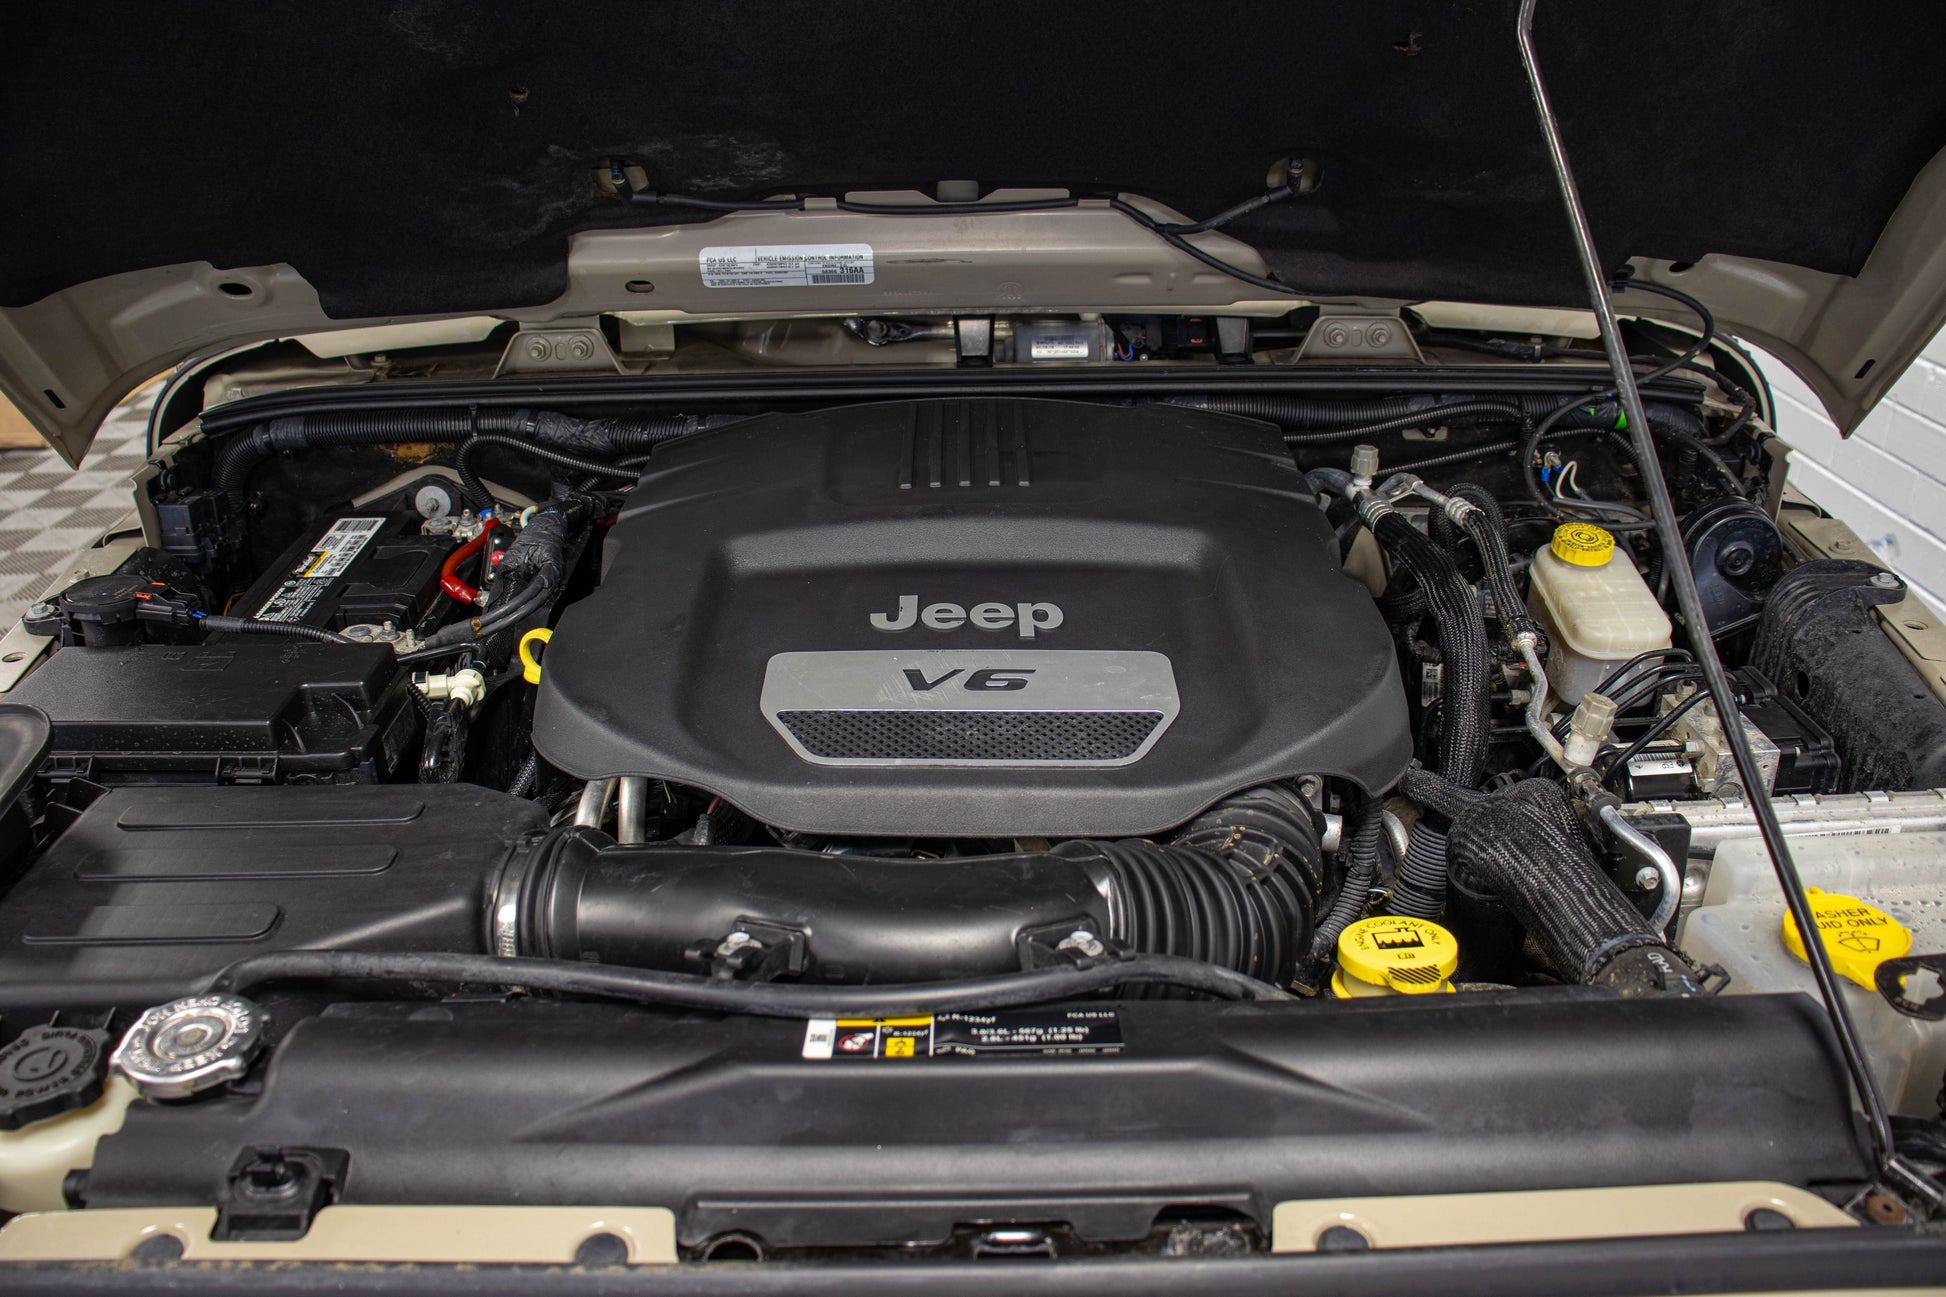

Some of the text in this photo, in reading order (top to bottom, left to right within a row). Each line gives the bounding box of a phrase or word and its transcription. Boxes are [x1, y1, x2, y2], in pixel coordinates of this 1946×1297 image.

[870, 595, 1064, 638] Jeep
[902, 668, 1036, 692] V6
[1815, 907, 1869, 918] ASHER
[1815, 916, 1888, 929] UID ONLY
[1354, 920, 1440, 951] ENGINE COOLANT ONLY
